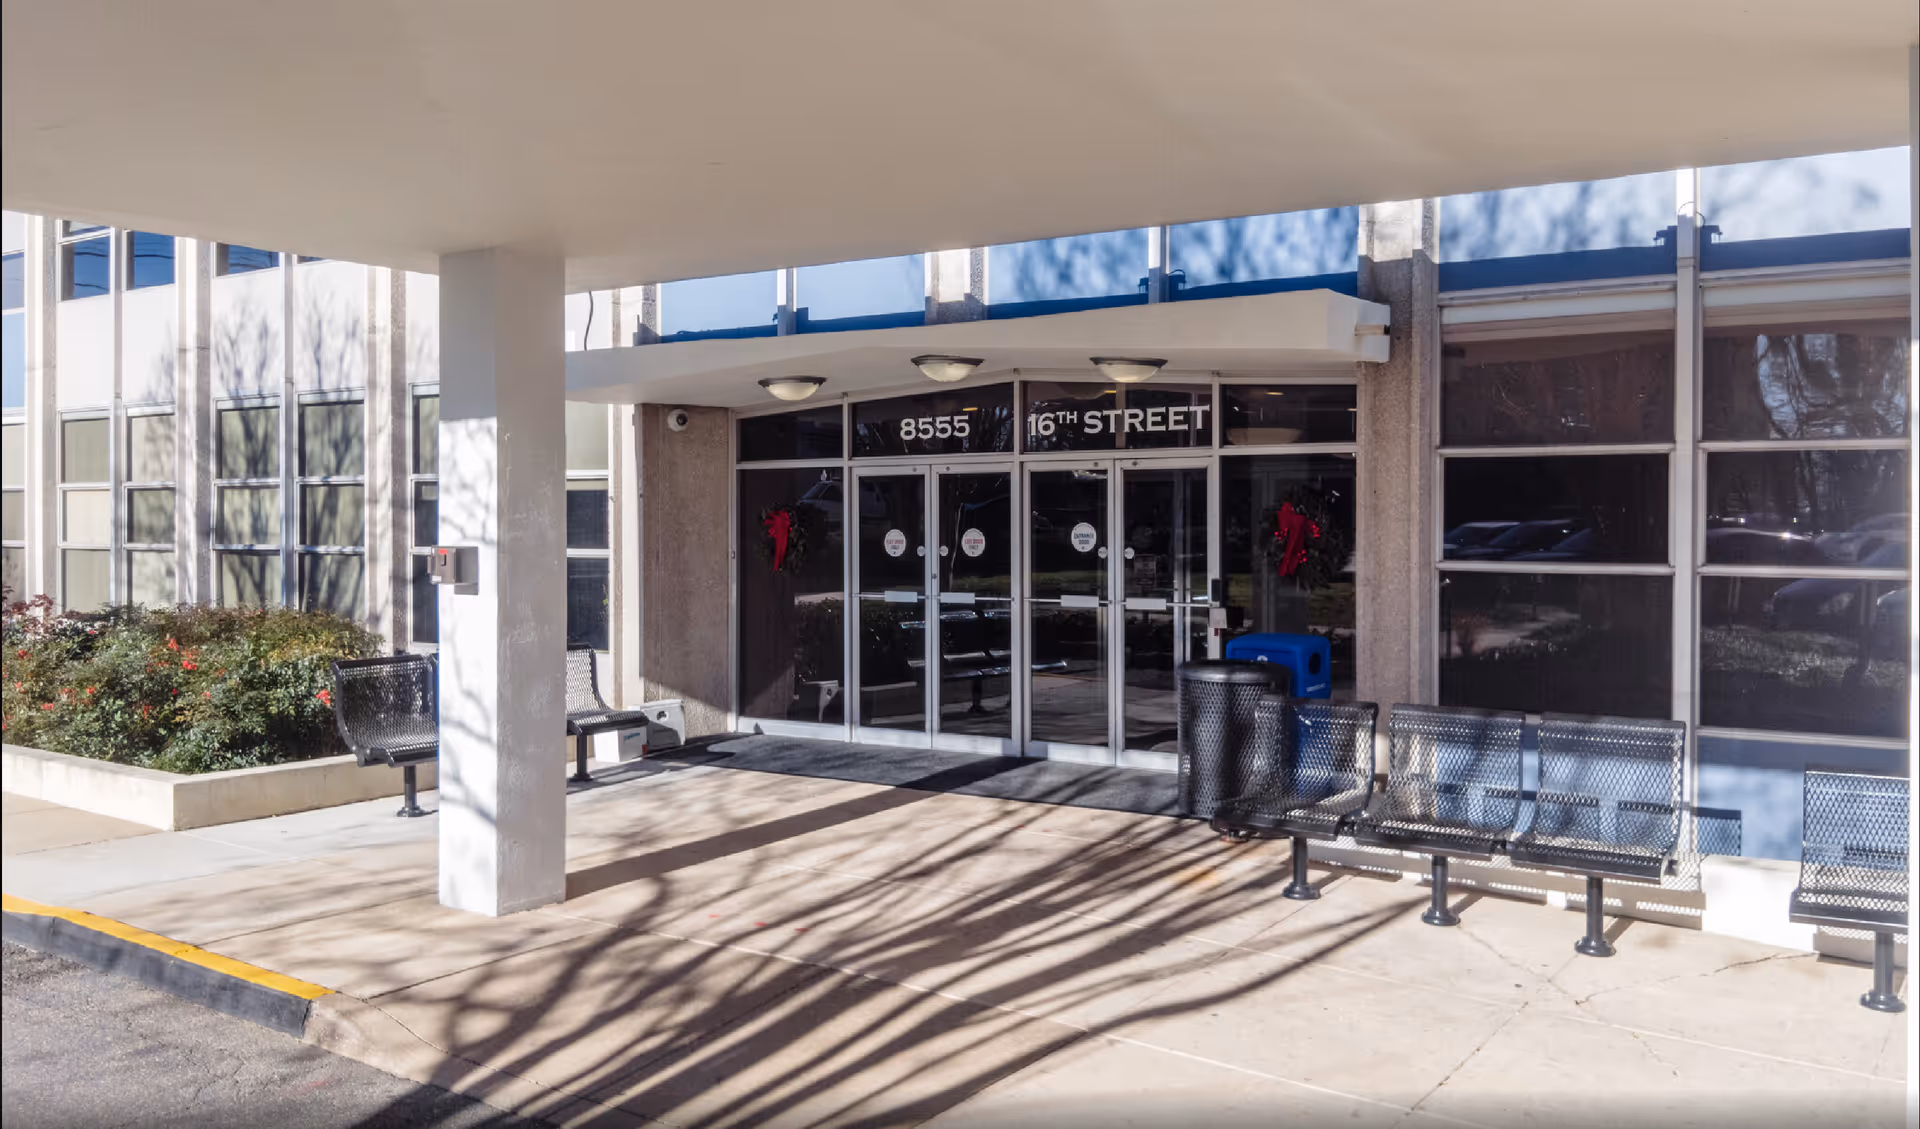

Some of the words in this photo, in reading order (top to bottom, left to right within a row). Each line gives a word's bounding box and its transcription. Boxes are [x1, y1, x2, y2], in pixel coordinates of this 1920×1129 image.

[900, 415, 970, 440] 8555
[1029, 411, 1077, 436] 16TH
[1083, 405, 1210, 434] STREET
